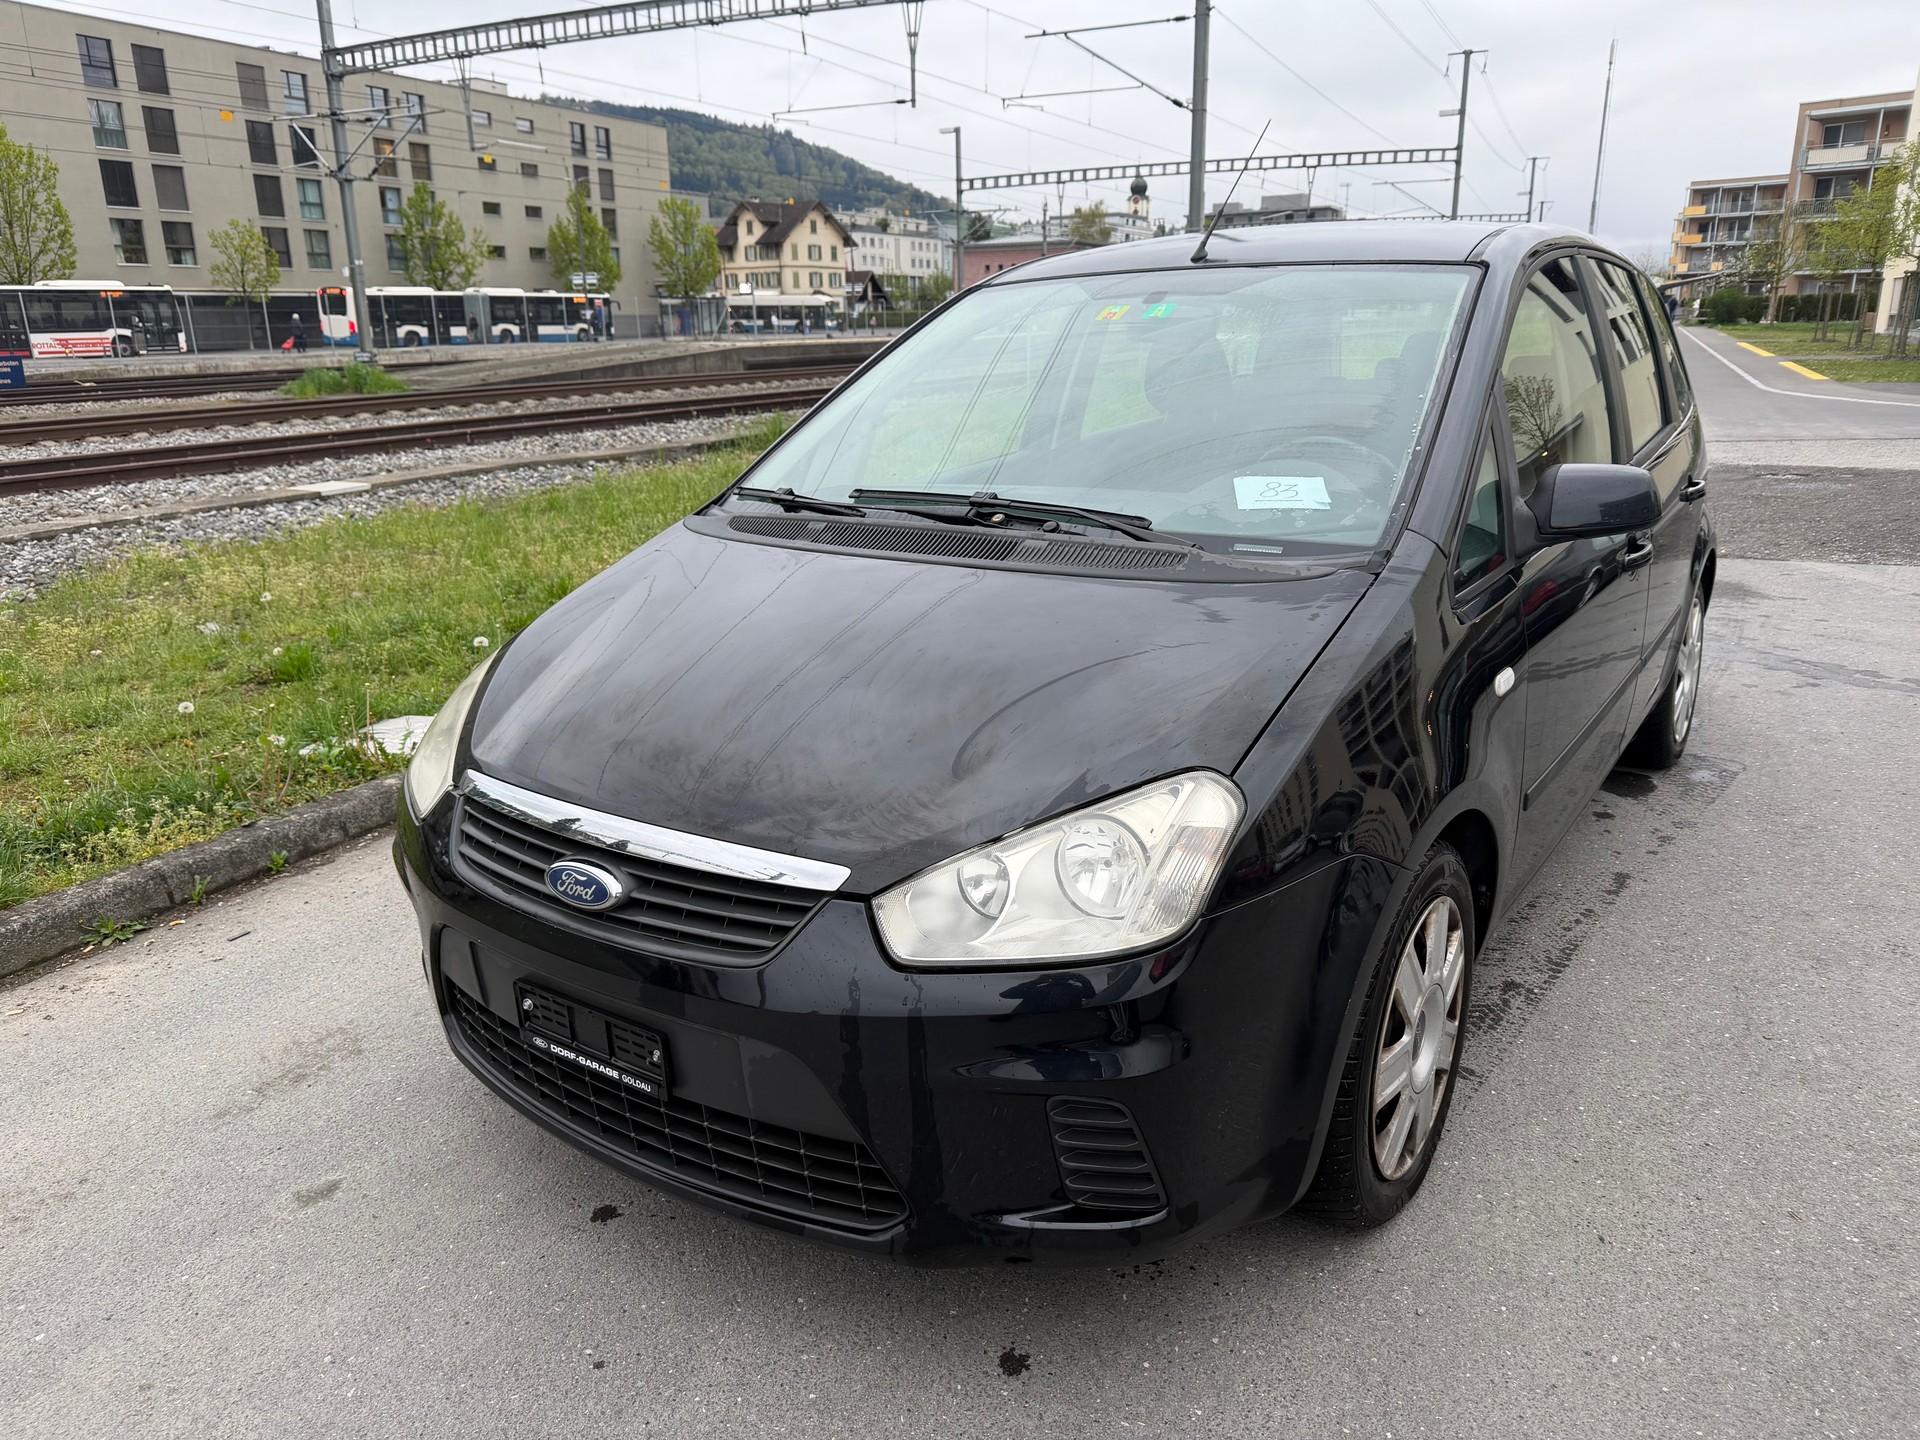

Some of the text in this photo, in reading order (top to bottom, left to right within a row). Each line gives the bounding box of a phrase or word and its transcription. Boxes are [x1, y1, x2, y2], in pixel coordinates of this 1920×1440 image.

[1259, 481, 1299, 499] 83
[556, 870, 597, 901] Ford
[550, 1044, 619, 1079] DORF-GARAGE
[621, 1074, 651, 1092] GOLDAU
